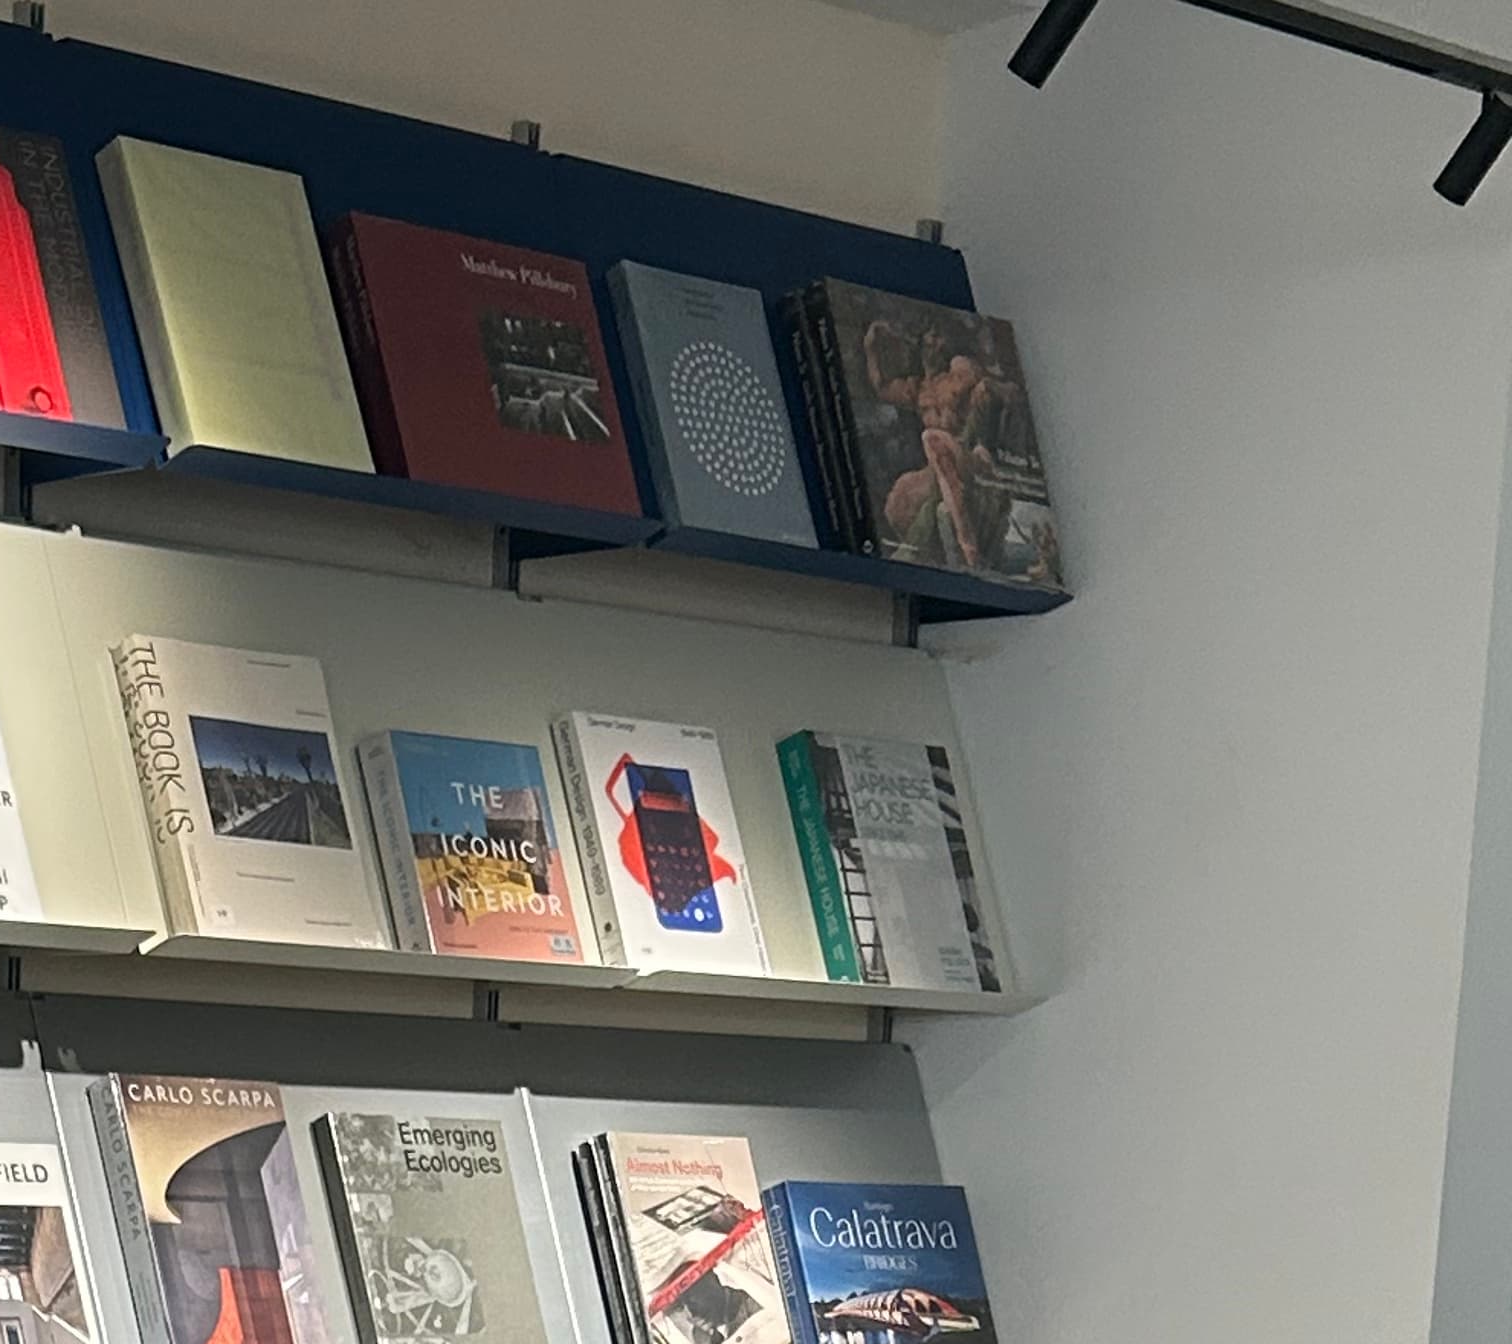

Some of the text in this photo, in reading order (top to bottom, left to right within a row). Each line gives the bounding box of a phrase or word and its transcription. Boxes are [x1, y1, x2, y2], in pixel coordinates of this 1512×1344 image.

[129, 641, 166, 699] THE
[142, 710, 187, 795] BOOK
[449, 781, 505, 810] THE
[164, 807, 196, 836] IS
[439, 831, 538, 864] ICONIC
[436, 883, 566, 918] INTERIOR
[127, 1084, 276, 1109] CARLO SCARPA
[396, 1120, 497, 1153] Emerging
[403, 1149, 503, 1178] Ecologies
[116, 1162, 142, 1238] SCARPA
[809, 1206, 958, 1250] Calatrava
